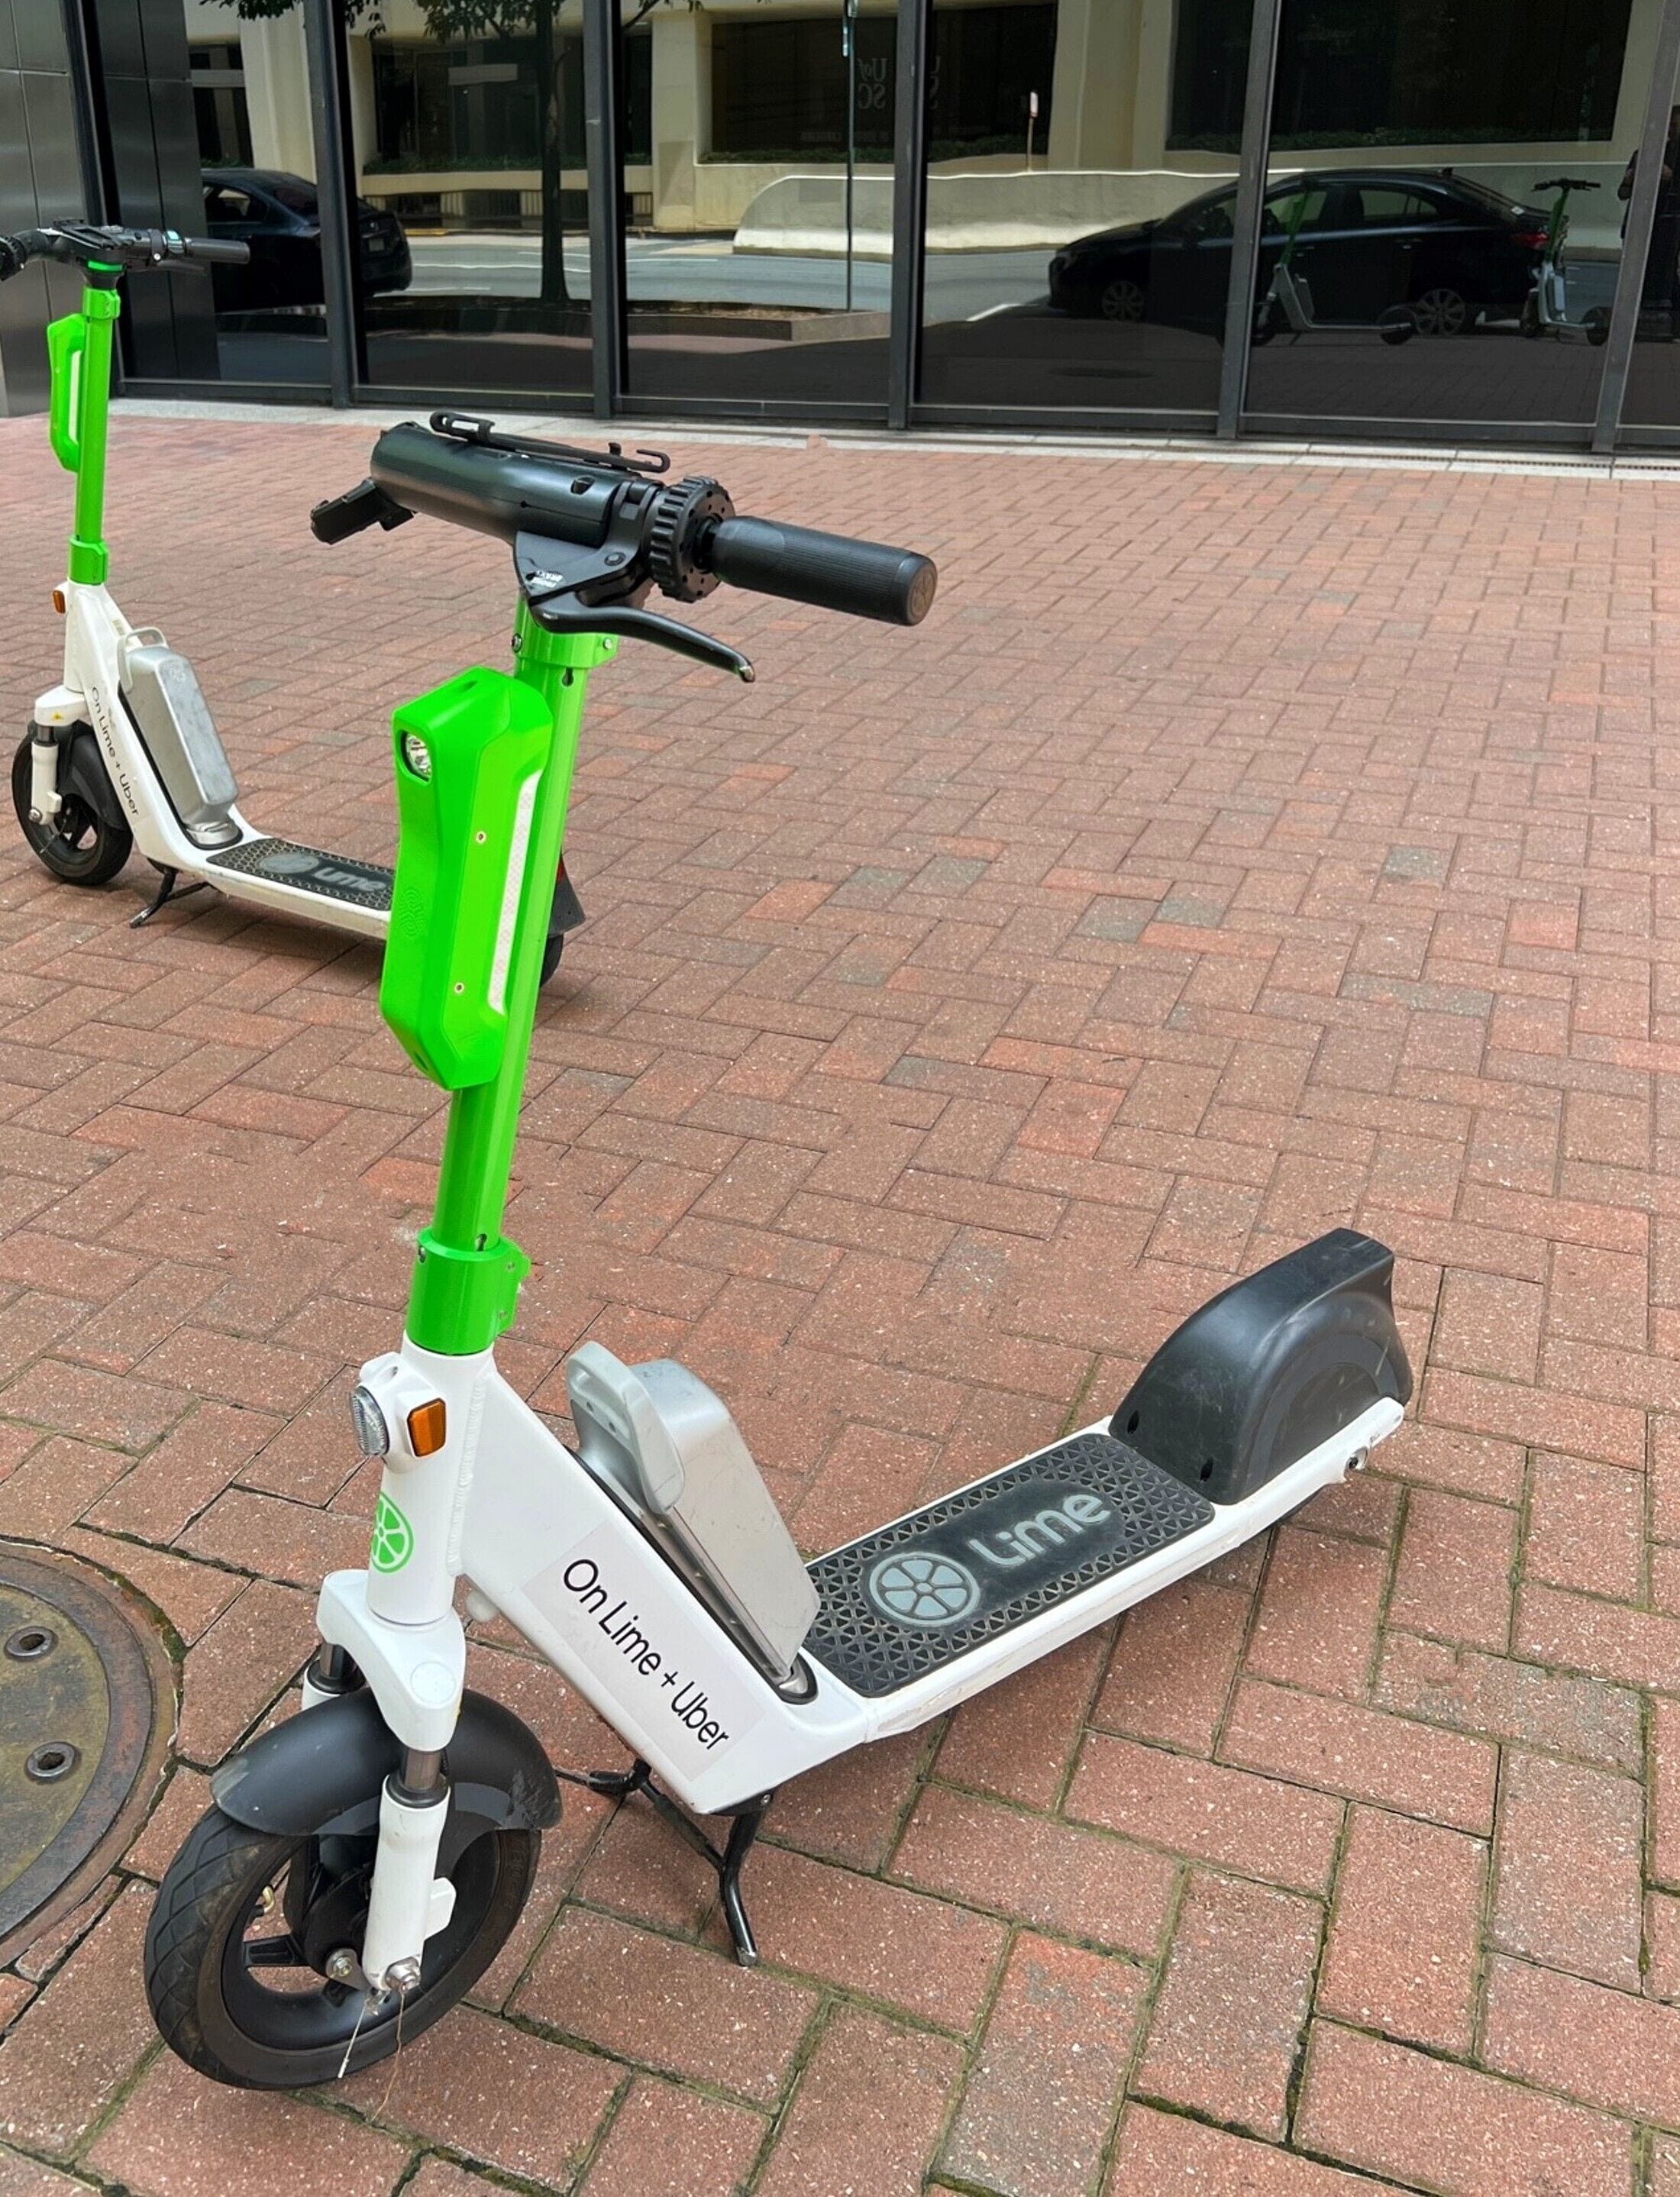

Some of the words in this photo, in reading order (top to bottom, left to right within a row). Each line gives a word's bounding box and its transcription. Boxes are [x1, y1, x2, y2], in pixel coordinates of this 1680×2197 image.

[92, 687, 102, 714] On
[99, 716, 116, 758] Lime
[119, 773, 139, 816] Uber
[968, 1494, 1111, 1566] Lime
[564, 1559, 608, 1614] On
[598, 1601, 661, 1675] Lime
[661, 1671, 678, 1688] +
[671, 1681, 729, 1750] Uber
